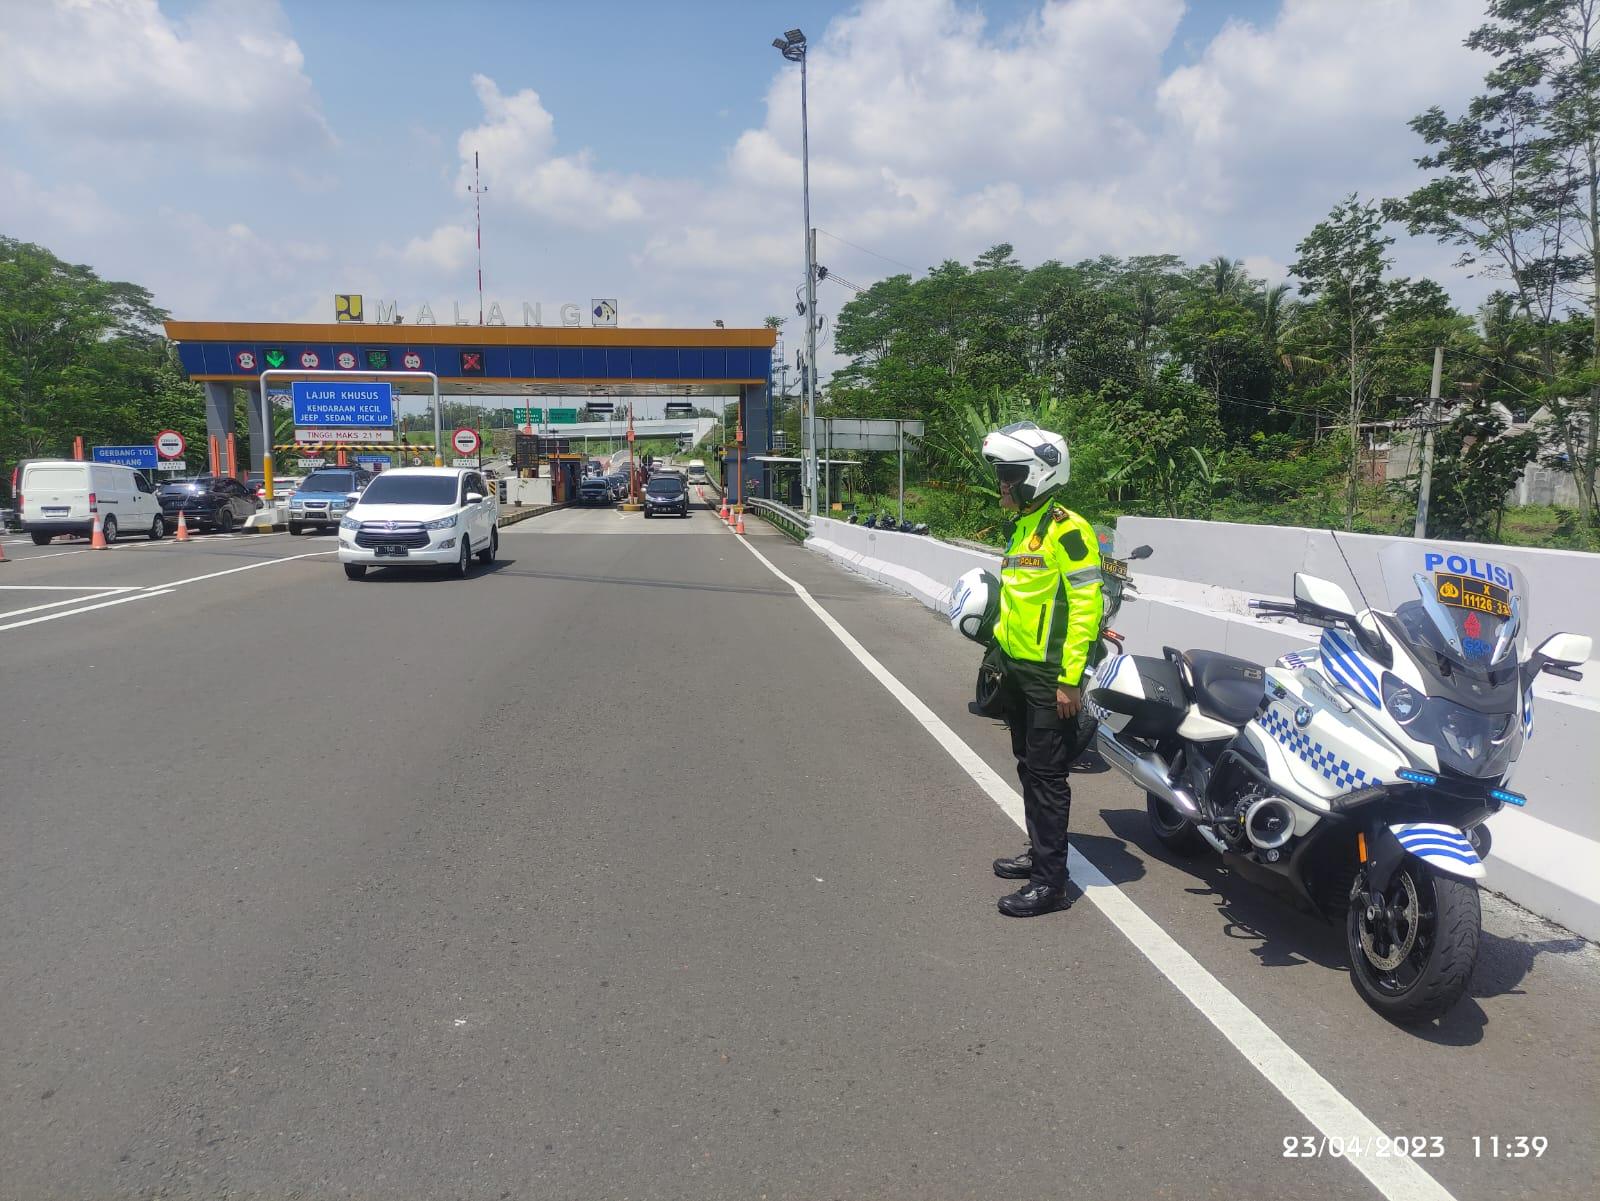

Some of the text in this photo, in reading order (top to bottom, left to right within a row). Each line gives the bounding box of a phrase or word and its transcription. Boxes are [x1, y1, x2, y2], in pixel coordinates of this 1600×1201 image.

[377, 299, 581, 326] MALANG
[306, 391, 379, 400] LAJUR KHUSUS
[359, 405, 381, 413] KECIL
[99, 449, 153, 457] GERBANG TOL
[110, 458, 142, 466] MALANG
[1019, 557, 1041, 567] POLRI
[1424, 553, 1513, 589] POLISI
[1483, 584, 1491, 596] X
[1462, 637, 1492, 652] G20
